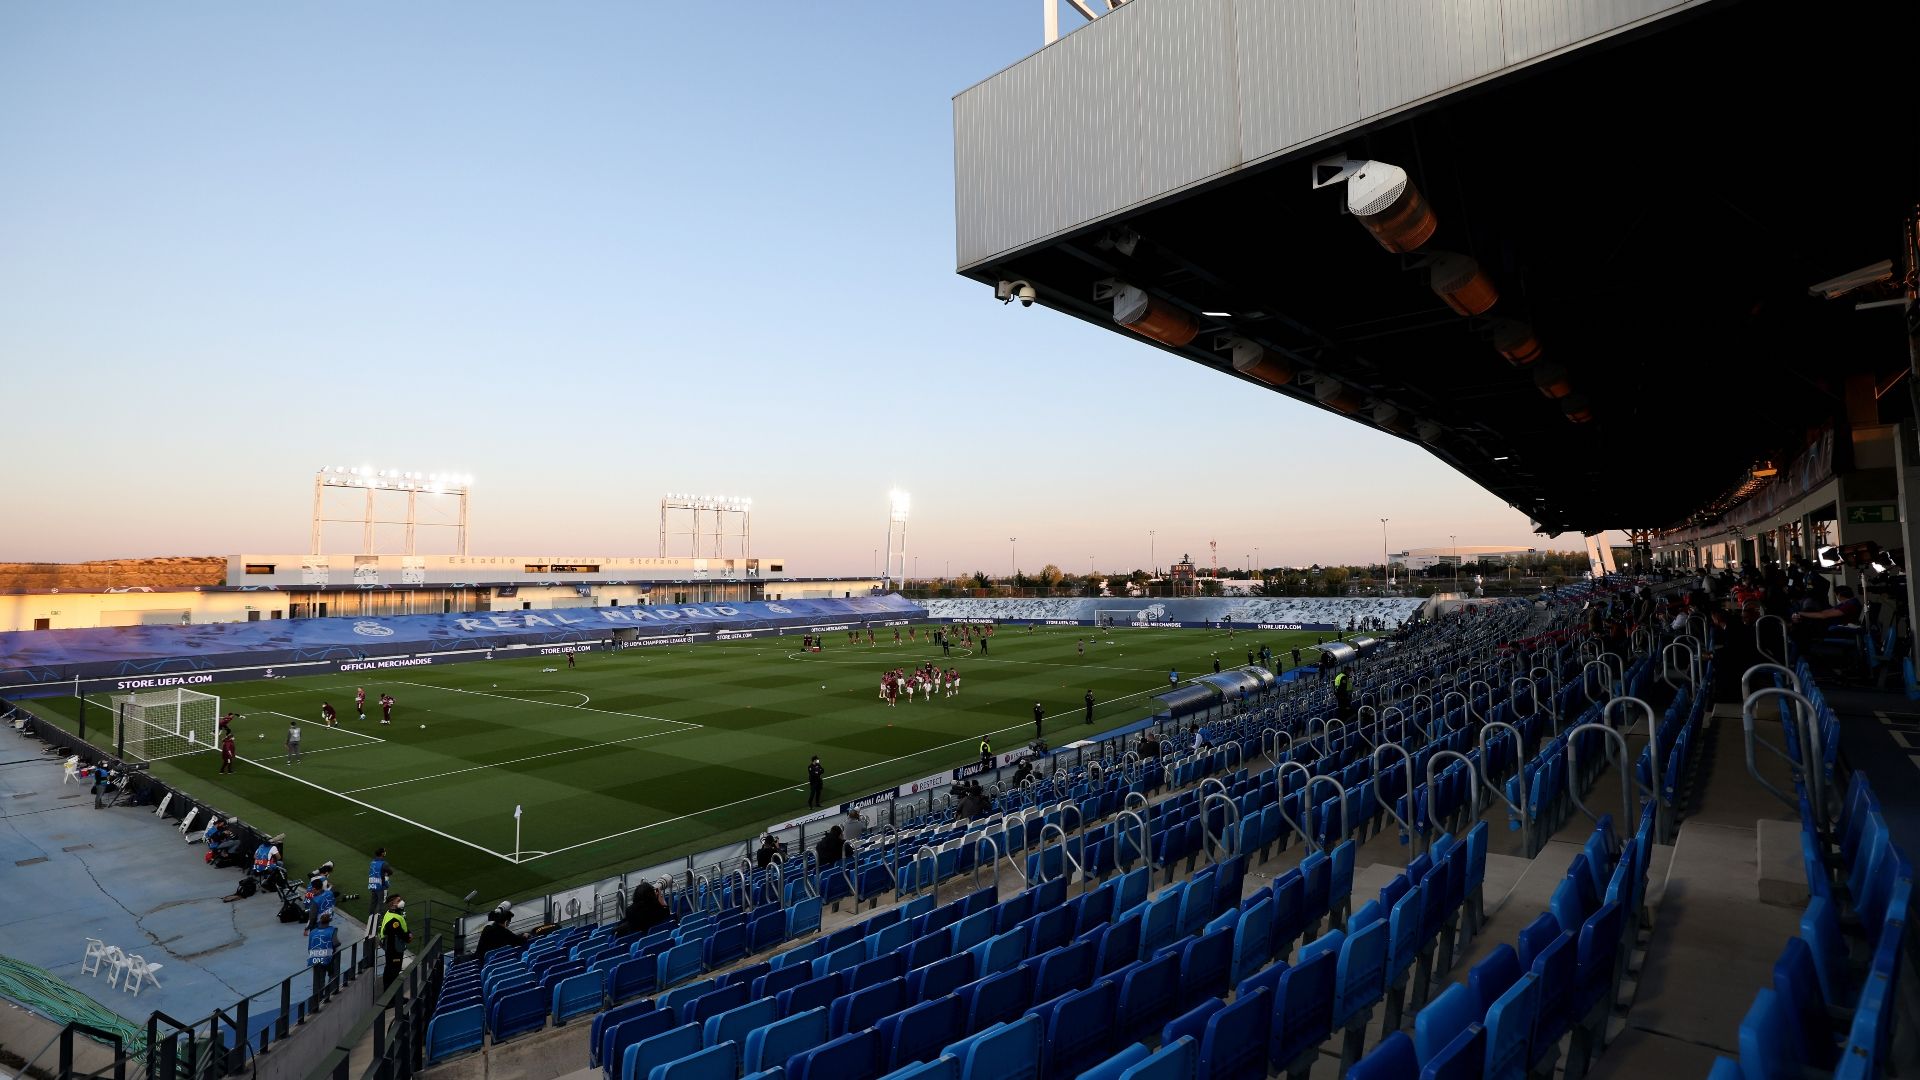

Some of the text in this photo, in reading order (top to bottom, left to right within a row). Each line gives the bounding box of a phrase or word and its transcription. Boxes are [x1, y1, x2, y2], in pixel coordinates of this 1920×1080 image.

[449, 556, 516, 564] Estadio
[605, 557, 618, 565] Di
[454, 606, 740, 631] REAL MADRID
[540, 645, 591, 655] STORE.UEFA.COM
[340, 657, 433, 671] OFFICIAL MERCHANDISE
[117, 674, 213, 690] STORE.UEFA.COM
[919, 776, 943, 790] RESPECT
